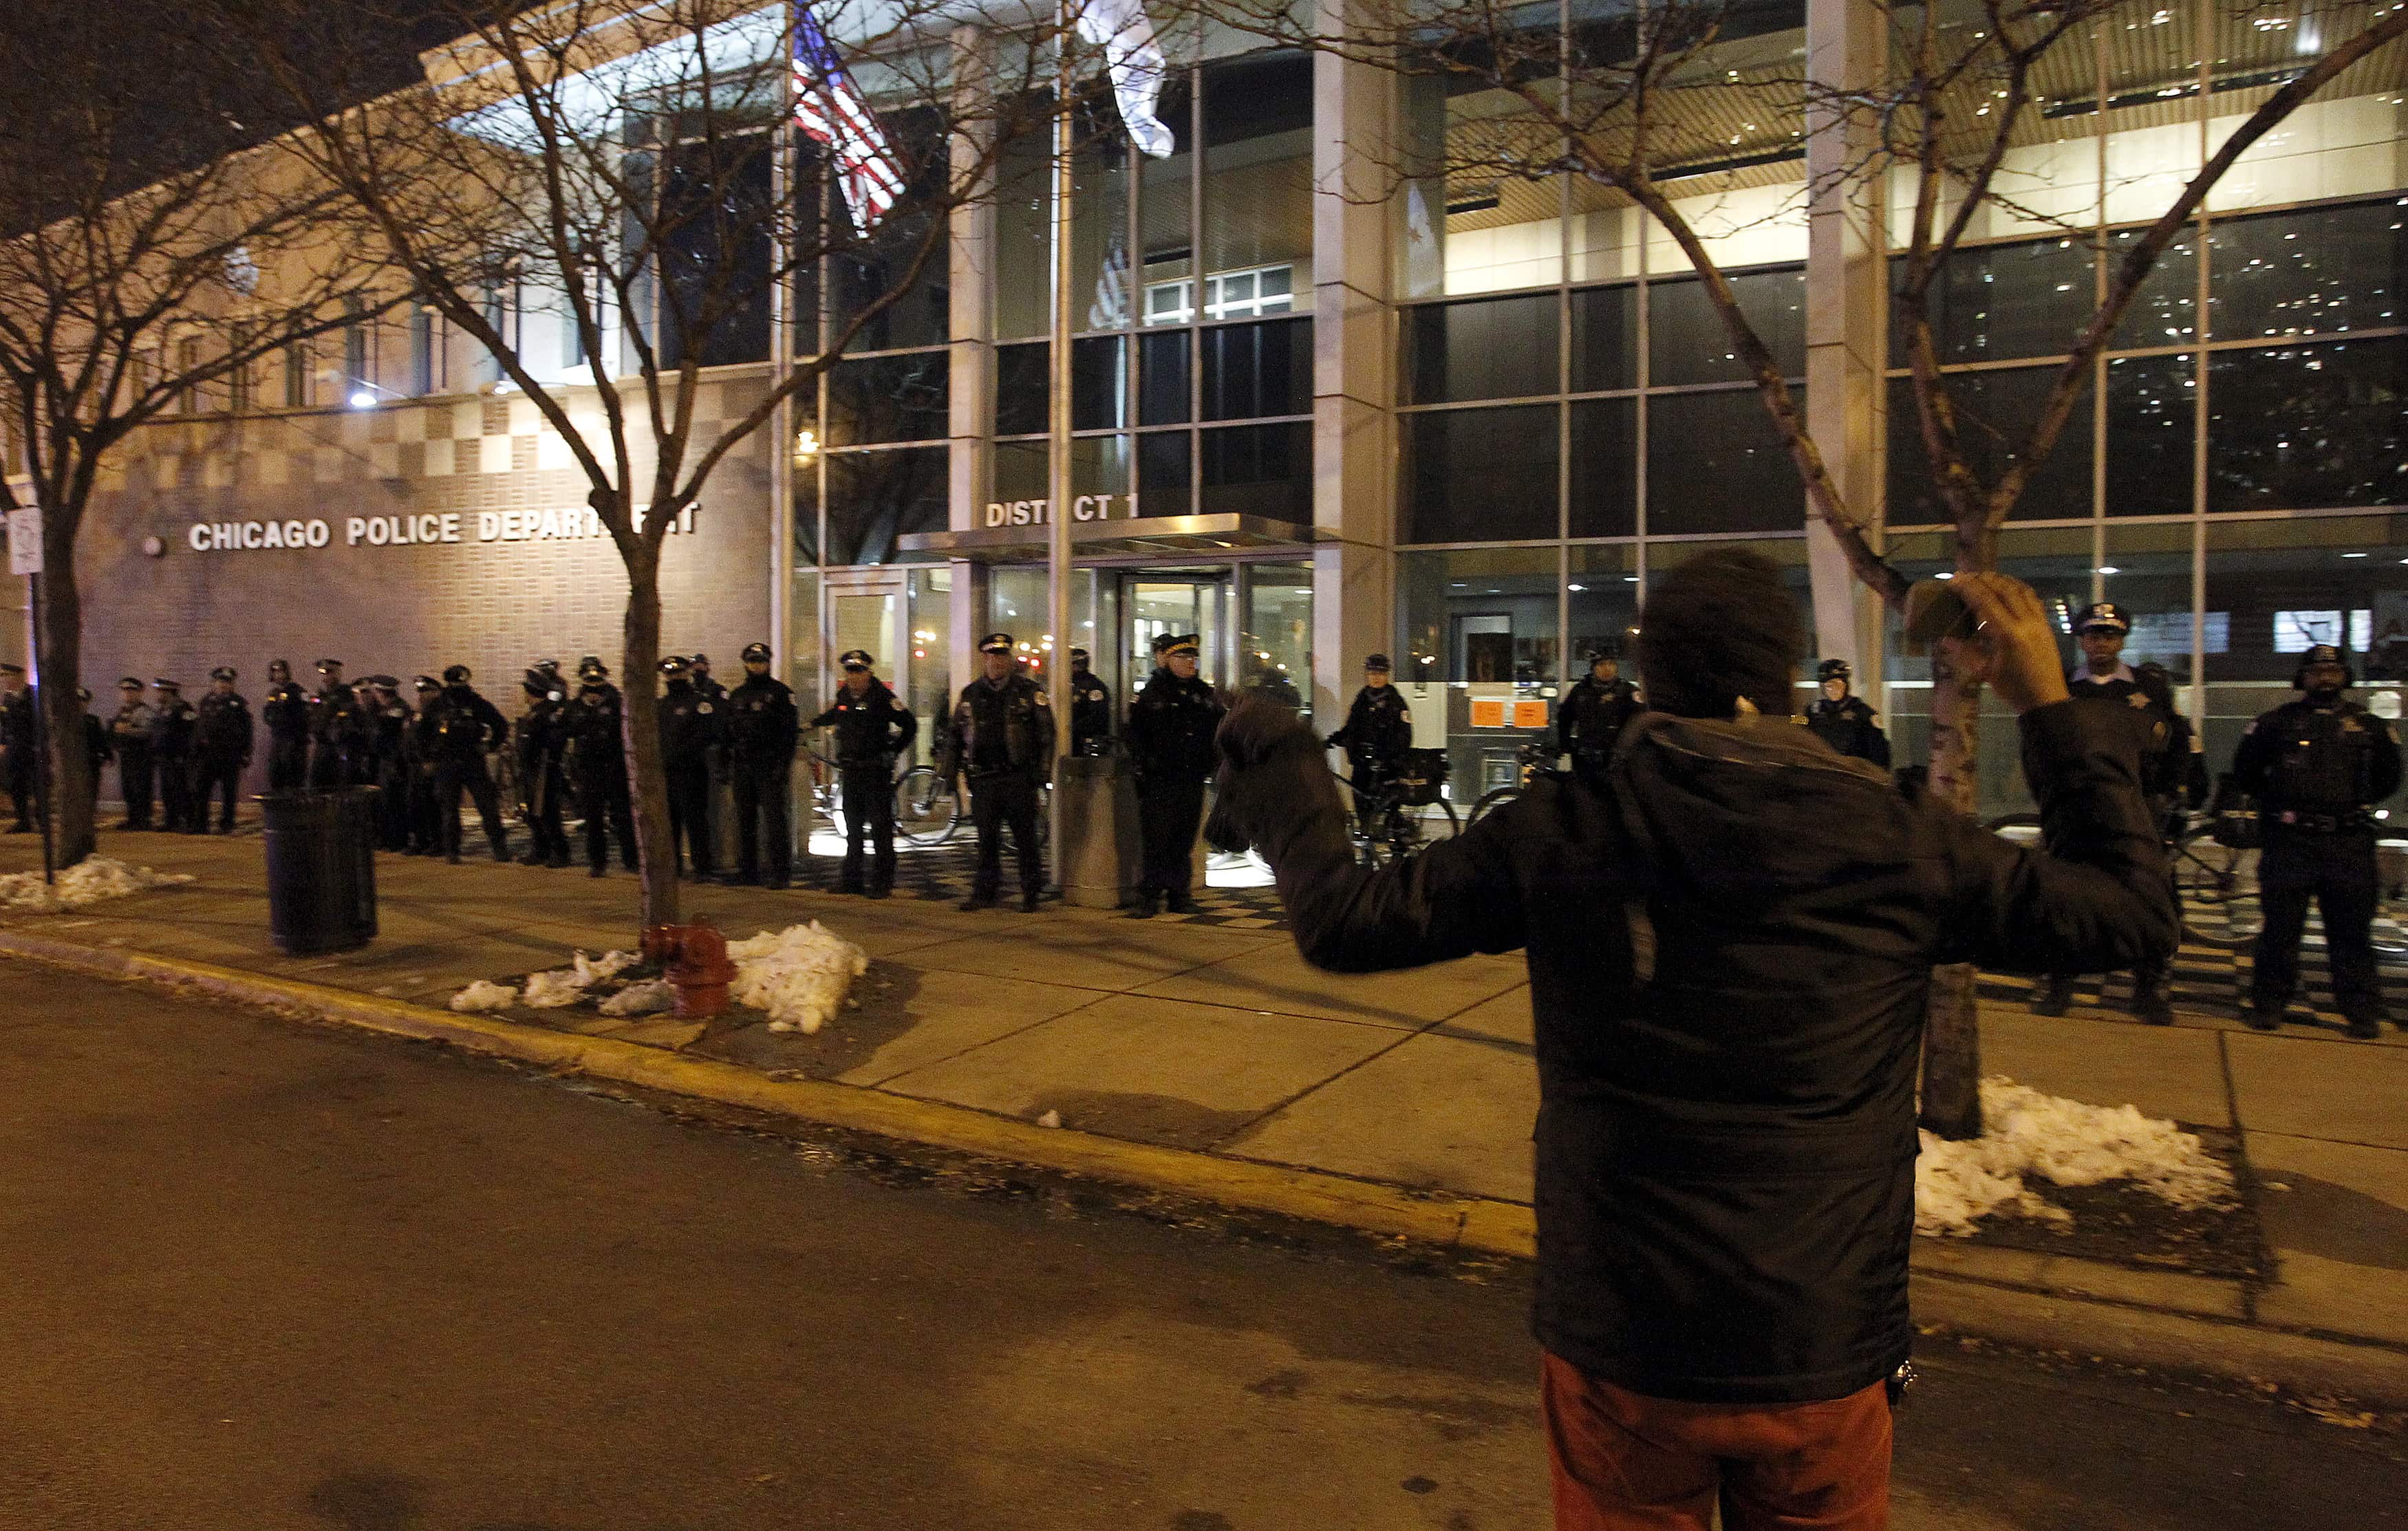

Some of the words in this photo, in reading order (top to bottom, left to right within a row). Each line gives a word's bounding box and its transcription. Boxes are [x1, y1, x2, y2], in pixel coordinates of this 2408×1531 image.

[189, 519, 330, 551] CHICAGO
[347, 513, 462, 546] POLICE
[479, 501, 700, 541] DEPARTET
[985, 494, 1112, 528] DISTCT
